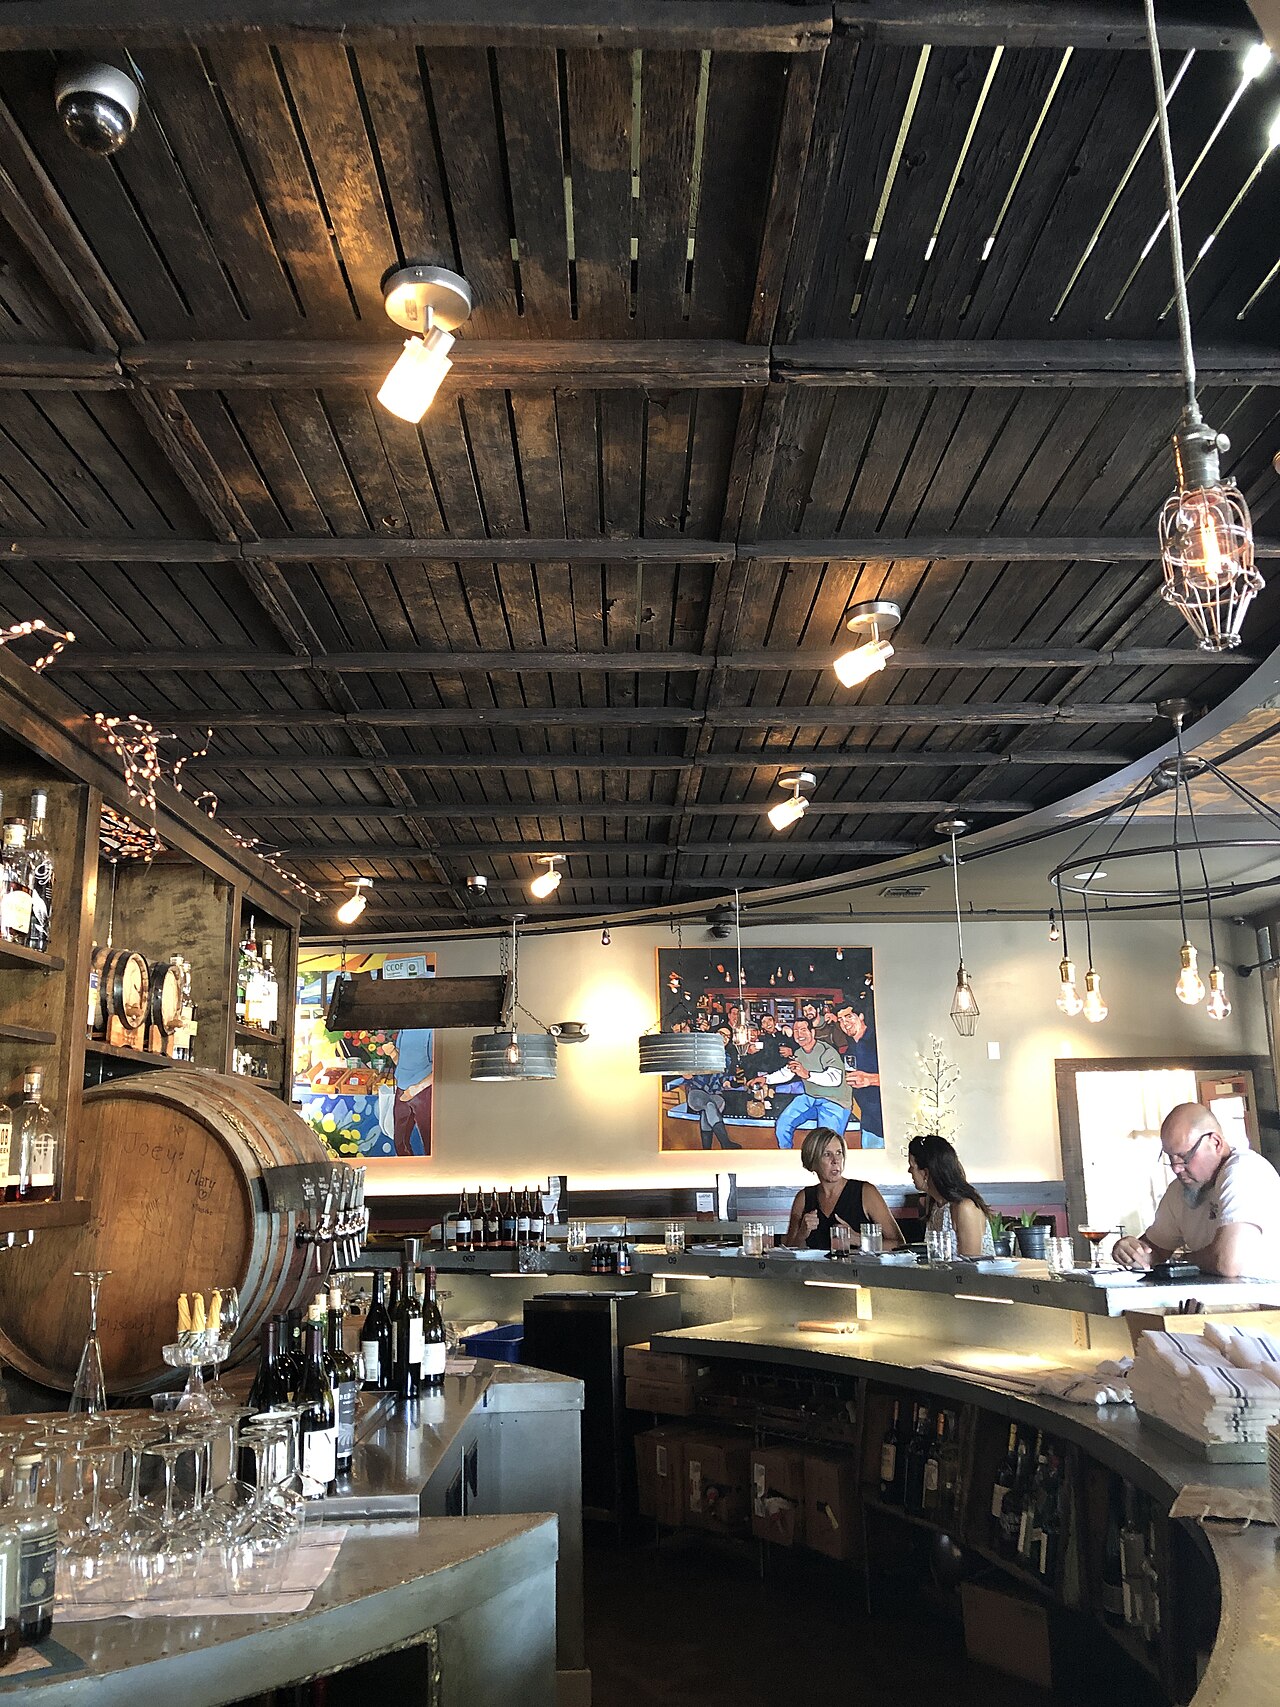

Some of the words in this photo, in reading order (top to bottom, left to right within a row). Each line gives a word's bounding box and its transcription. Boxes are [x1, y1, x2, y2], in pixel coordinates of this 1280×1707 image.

[385, 963, 404, 972] CCOF
[186, 1168, 216, 1197] Mary
[758, 1261, 766, 1270] 10
[852, 1268, 859, 1277] 11
[955, 1275, 963, 1285] 12
[1031, 1284, 1040, 1295] 13
